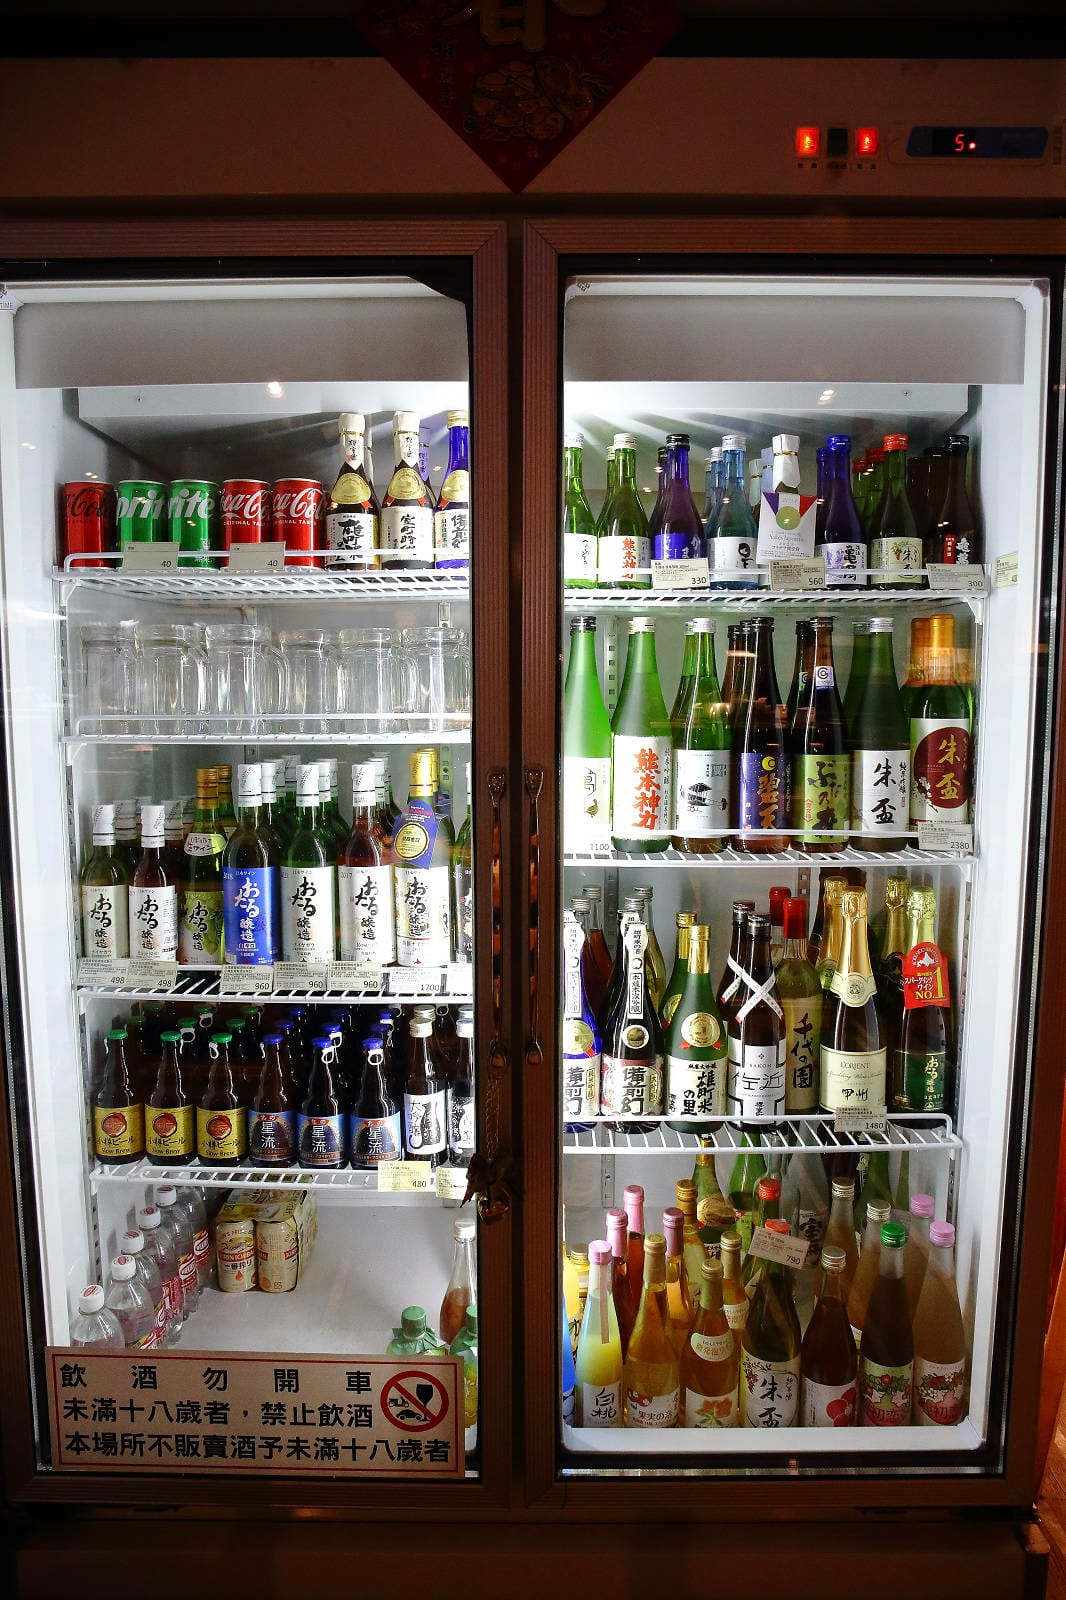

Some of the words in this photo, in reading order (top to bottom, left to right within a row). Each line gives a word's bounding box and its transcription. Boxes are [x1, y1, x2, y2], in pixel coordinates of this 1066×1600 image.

[161, 560, 172, 568] 40
[691, 576, 707, 585] 330
[808, 576, 823, 585] 560
[968, 580, 983, 588] 300
[935, 733, 961, 800] 朱盃
[631, 748, 661, 830] 熊本神力
[870, 757, 897, 825] 朱盃
[950, 841, 970, 850] 2380
[111, 976, 125, 985] 498
[157, 979, 172, 988] 498
[308, 980, 323, 989] 960
[363, 980, 378, 989] 960
[255, 982, 270, 991] 960
[420, 984, 440, 992] 1700
[917, 983, 934, 992] ワイン
[790, 1012, 814, 1089] 千代の園
[841, 1087, 869, 1101] 甲州
[865, 1122, 884, 1130] 1480
[261, 1121, 276, 1149] 星流
[311, 1126, 327, 1153] 星流
[201, 1138, 240, 1149] 小樽ビール
[368, 1127, 384, 1154] 星流
[412, 1180, 427, 1188] 480
[786, 1254, 801, 1265] 790
[591, 1387, 617, 1419] 白桃
[65, 1431, 451, 1463] 本場所不販賣酒予未滿十八歲者
